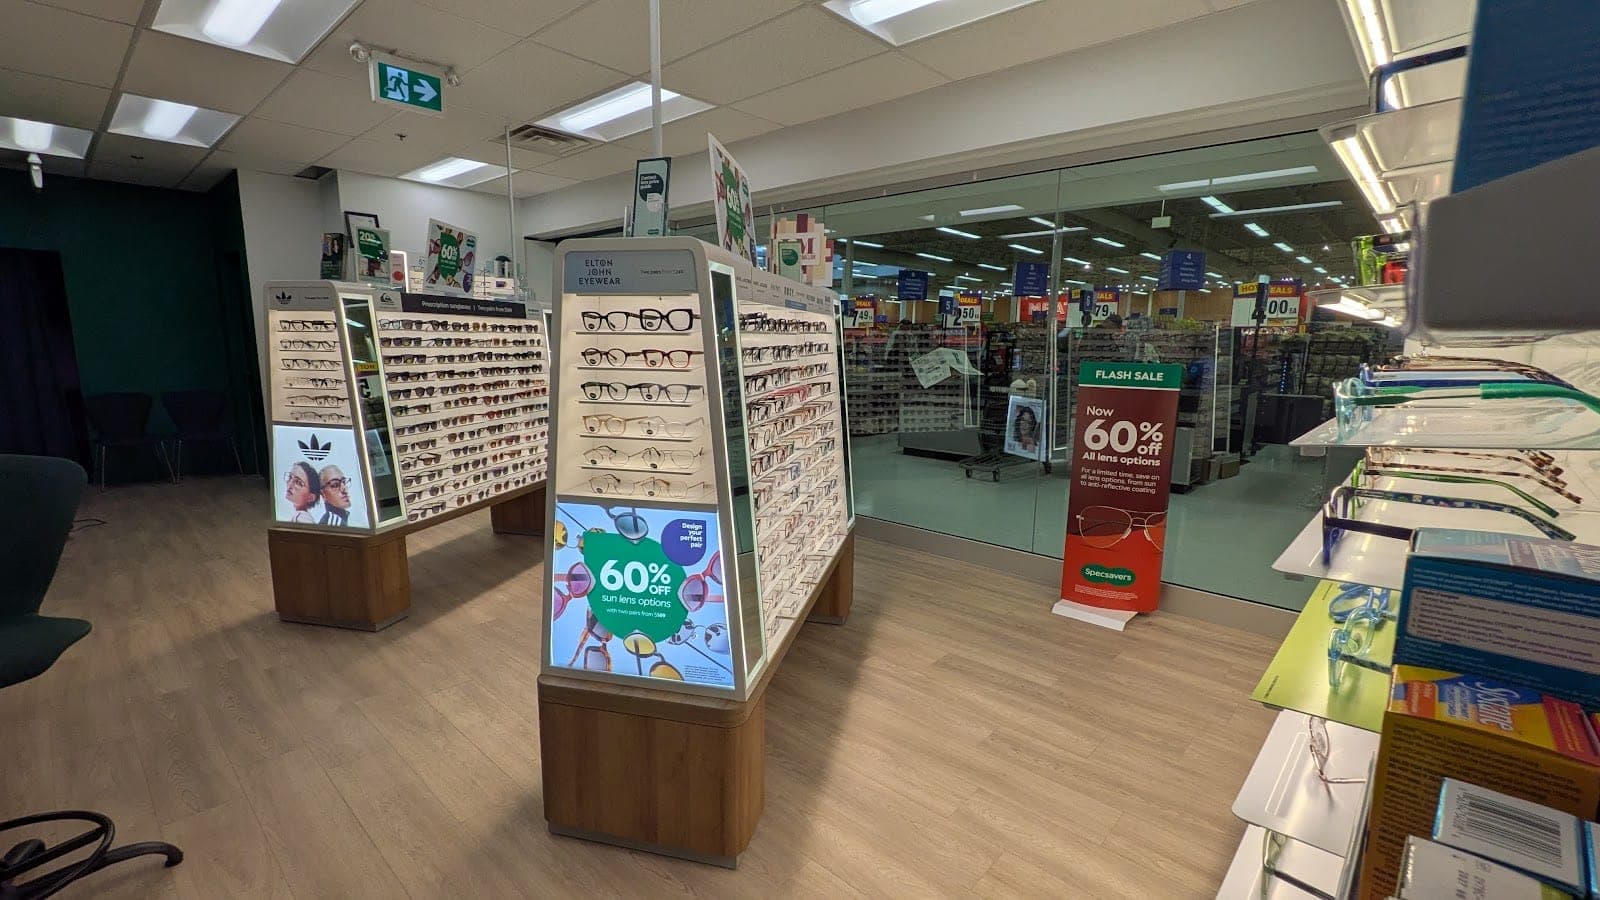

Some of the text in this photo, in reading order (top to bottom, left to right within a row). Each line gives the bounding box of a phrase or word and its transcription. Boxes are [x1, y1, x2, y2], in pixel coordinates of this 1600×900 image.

[1096, 370, 1164, 381] FLASH SALE
[1087, 406, 1113, 416] Now
[1084, 419, 1163, 453] 60%
[1137, 442, 1162, 455] off
[1082, 452, 1160, 466] All lens options
[1088, 481, 1130, 491] anti-reflective
[1132, 486, 1156, 494] coating
[600, 560, 671, 593] 60%
[1085, 568, 1132, 581] Specsavers
[649, 586, 671, 596] OFF
[601, 594, 672, 608] sun lens options
